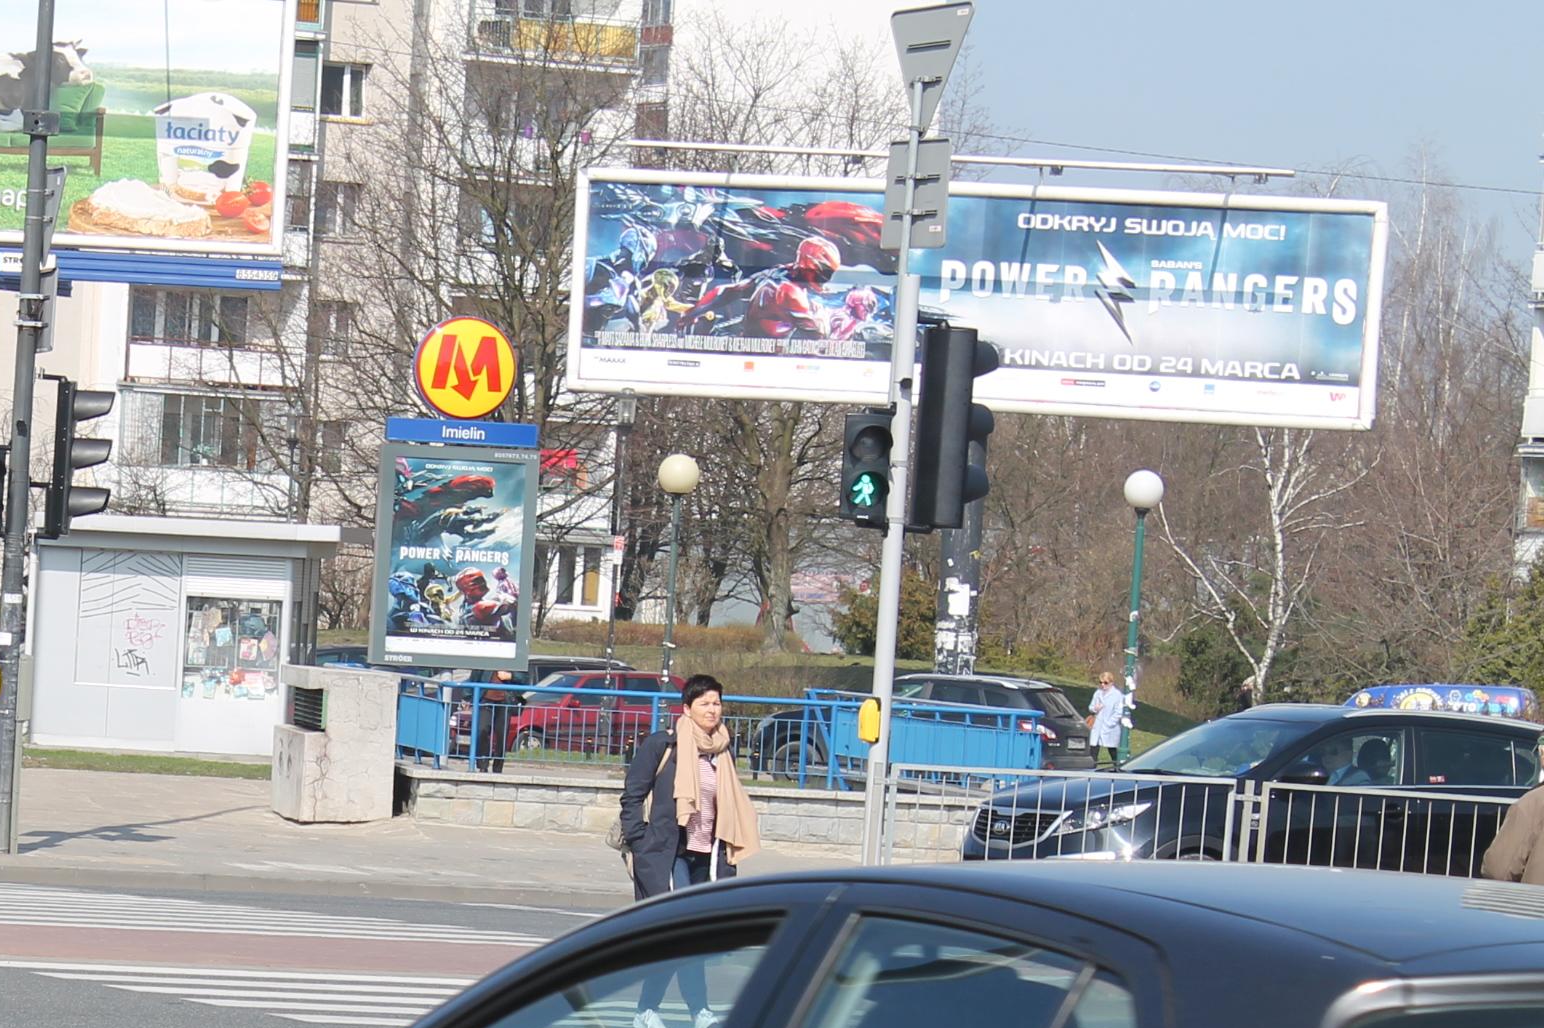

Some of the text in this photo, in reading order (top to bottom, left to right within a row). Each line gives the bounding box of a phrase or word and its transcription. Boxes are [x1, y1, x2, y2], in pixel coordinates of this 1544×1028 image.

[166, 121, 240, 146] łaciaty
[1017, 212, 1287, 241] ODKRYJ SWOJĄ MOC!
[939, 259, 1358, 326] POWER RANGERS
[1004, 348, 1302, 380] KINACH OD 24 MARCA
[441, 425, 486, 441] Imielin
[399, 546, 510, 566] POWER RANGERS
